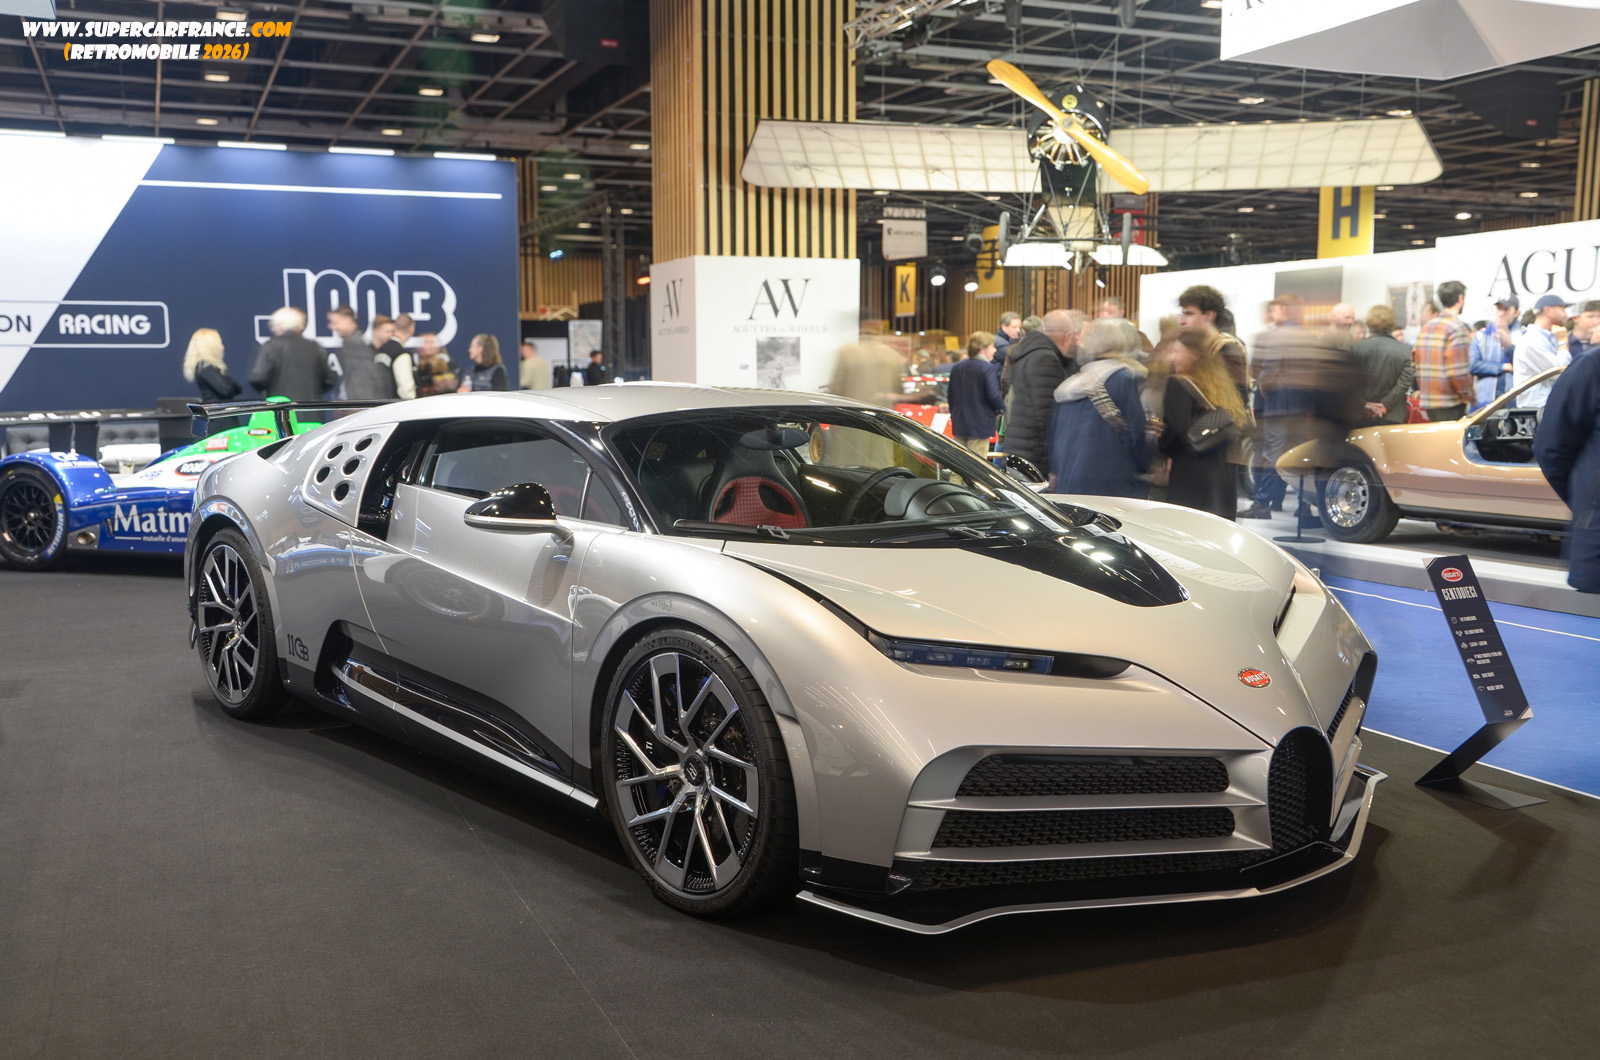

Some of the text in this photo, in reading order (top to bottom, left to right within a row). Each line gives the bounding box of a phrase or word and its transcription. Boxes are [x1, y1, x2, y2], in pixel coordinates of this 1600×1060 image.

[1332, 186, 1360, 240] H
[900, 274, 911, 303] K
[1487, 244, 1600, 297] AGU
[661, 278, 684, 324] AW
[746, 278, 813, 321] AW
[58, 313, 151, 335] RACING
[1441, 585, 1479, 601] CENTODIECI
[1244, 672, 1269, 683] BUGATTI
